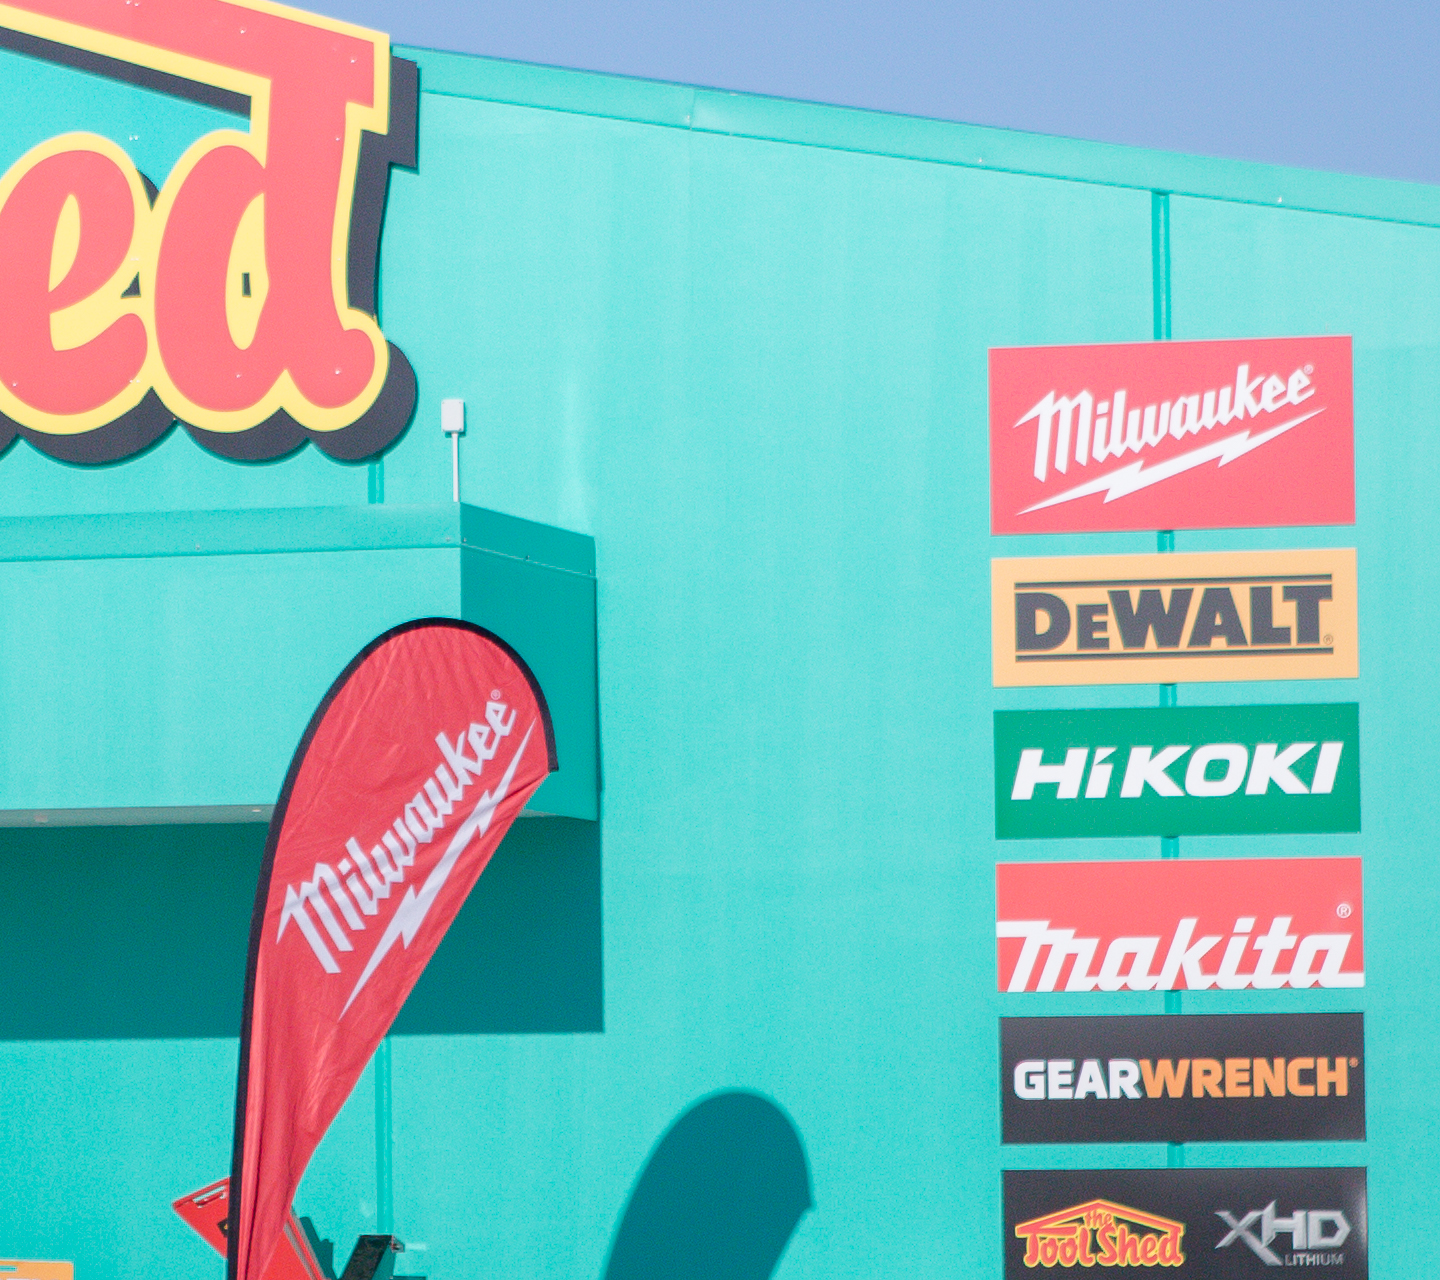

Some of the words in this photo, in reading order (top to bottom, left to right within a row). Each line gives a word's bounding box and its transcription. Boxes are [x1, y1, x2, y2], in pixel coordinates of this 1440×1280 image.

[1013, 363, 1317, 483] Milwaukee
[276, 698, 519, 975] Milwaukee
[1013, 1058, 1349, 1101] GEARWRENCH
[1083, 1209, 1114, 1228] the
[1214, 1200, 1351, 1266] XHD
[1015, 1224, 1095, 1267] Tool
[1096, 1222, 1185, 1268] Shed
[1285, 1253, 1345, 1266] LITHIUM
